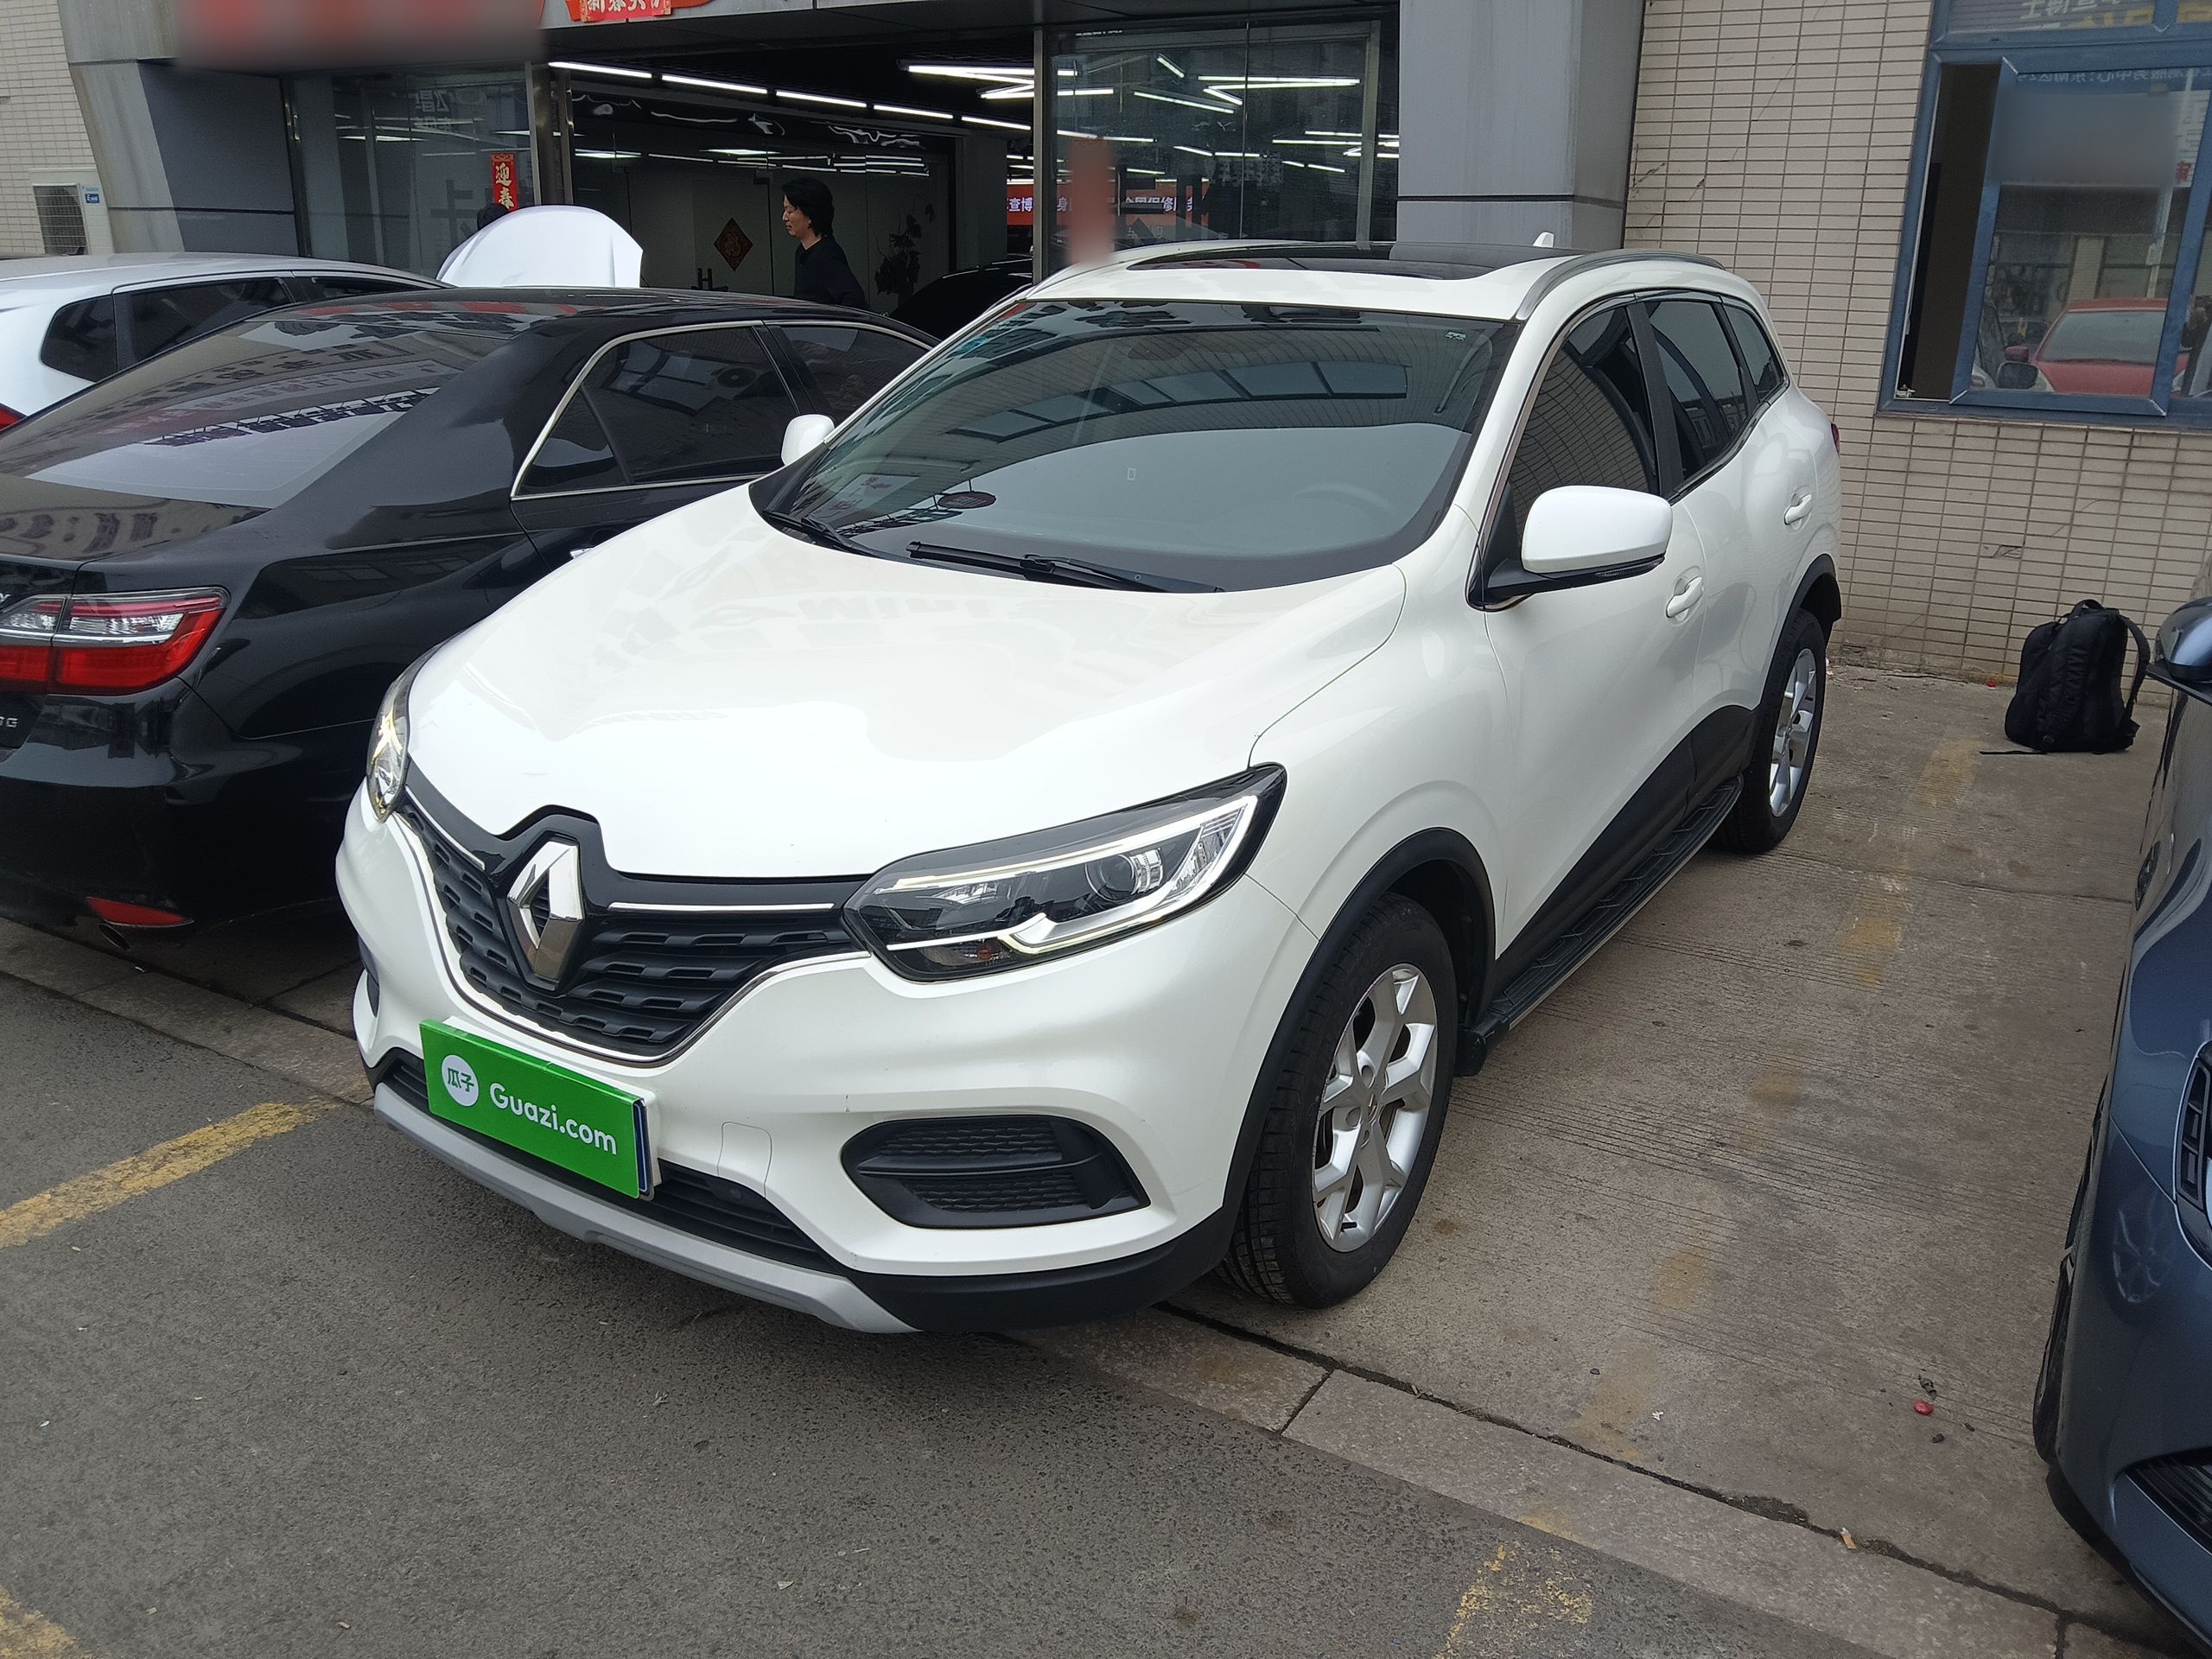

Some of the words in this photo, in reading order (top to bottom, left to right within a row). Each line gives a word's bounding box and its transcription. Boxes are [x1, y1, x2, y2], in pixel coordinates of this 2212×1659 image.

[495, 162, 515, 209] 迎春
[1007, 197, 1033, 213] 查博
[448, 1067, 474, 1092] 瓜子
[489, 1082, 617, 1155] Guazi.com
